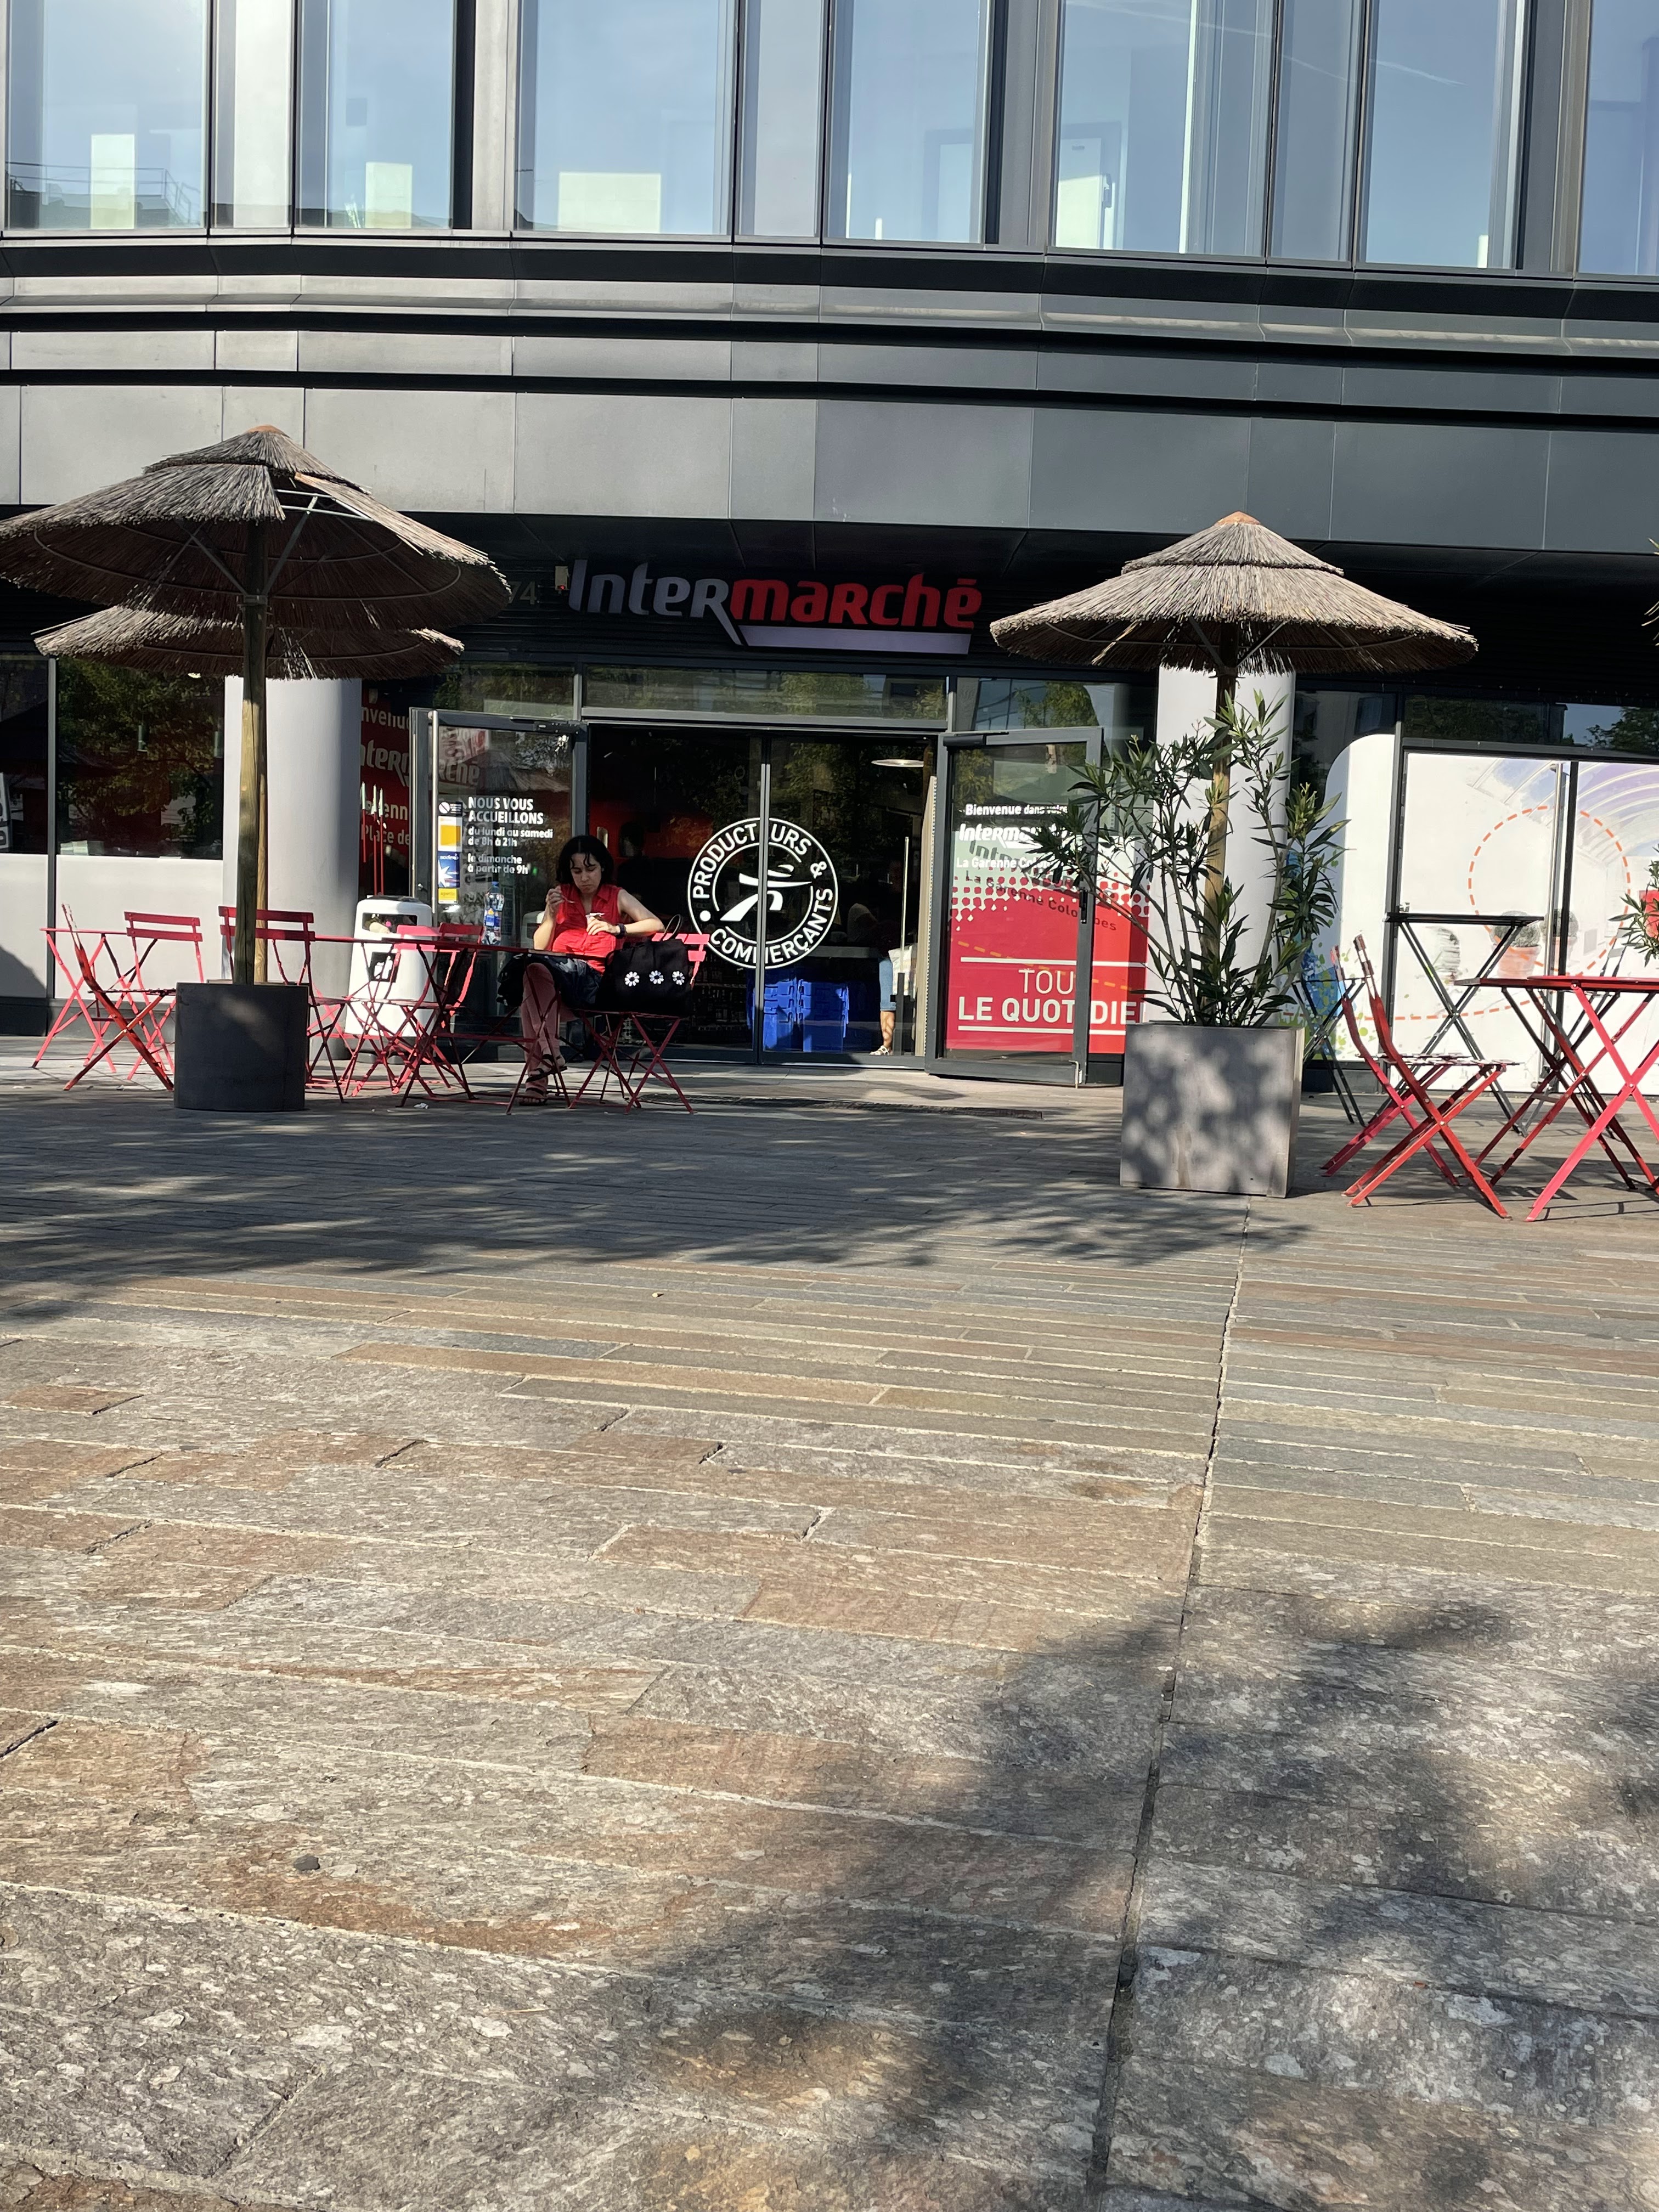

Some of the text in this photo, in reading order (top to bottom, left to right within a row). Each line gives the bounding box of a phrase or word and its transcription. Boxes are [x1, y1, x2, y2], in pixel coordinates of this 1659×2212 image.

[468, 797, 500, 810] NOUS
[503, 797, 534, 811] VOUS
[965, 804, 1021, 815] Bienvenue
[468, 810, 544, 825] ACCUEILLONS
[468, 826, 480, 836] du
[482, 827, 505, 837] lundi
[520, 829, 553, 838] samedi
[467, 836, 517, 847] de 8h à 21h
[467, 853, 522, 864] le dimanche
[692, 823, 812, 899] PRODUCTURS
[810, 860, 828, 879] &
[956, 857, 969, 868] La
[972, 856, 1017, 868] Garenne
[467, 864, 473, 873] à
[476, 865, 502, 874] partir
[503, 865, 515, 873] de
[516, 865, 529, 874] 9h
[1018, 969, 1074, 995] TOU
[958, 996, 1146, 1025] LE QUOTDIE
